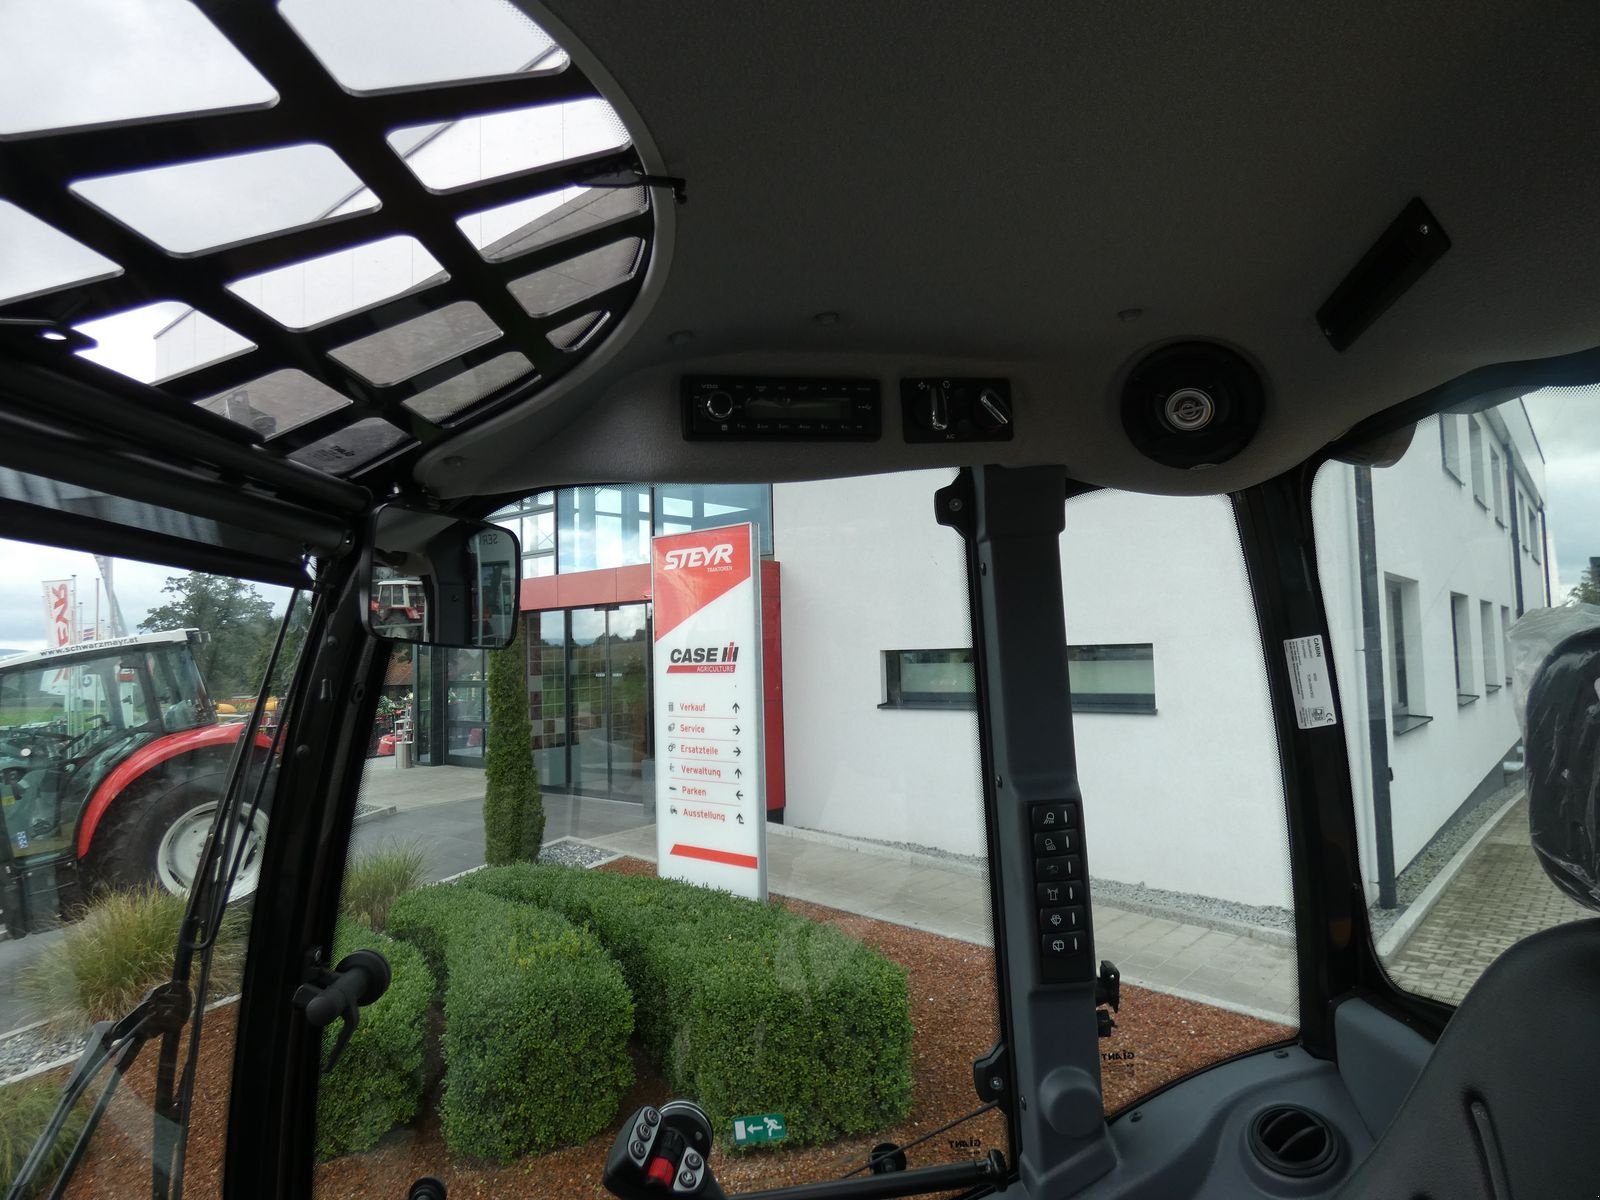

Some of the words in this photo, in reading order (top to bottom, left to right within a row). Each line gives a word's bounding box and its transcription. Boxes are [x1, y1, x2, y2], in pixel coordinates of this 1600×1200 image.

[663, 544, 733, 570] STEYR
[39, 636, 139, 657] www.schwarzmayr.at
[670, 647, 719, 664] CASE
[696, 665, 735, 673] AGRICULTURE
[679, 702, 706, 712] Verkauf
[680, 723, 705, 734] Service
[680, 744, 719, 756] Ersatzteile
[681, 765, 721, 778] Verwaltung
[681, 785, 707, 797] Parken
[683, 807, 726, 822] Ausstellung
